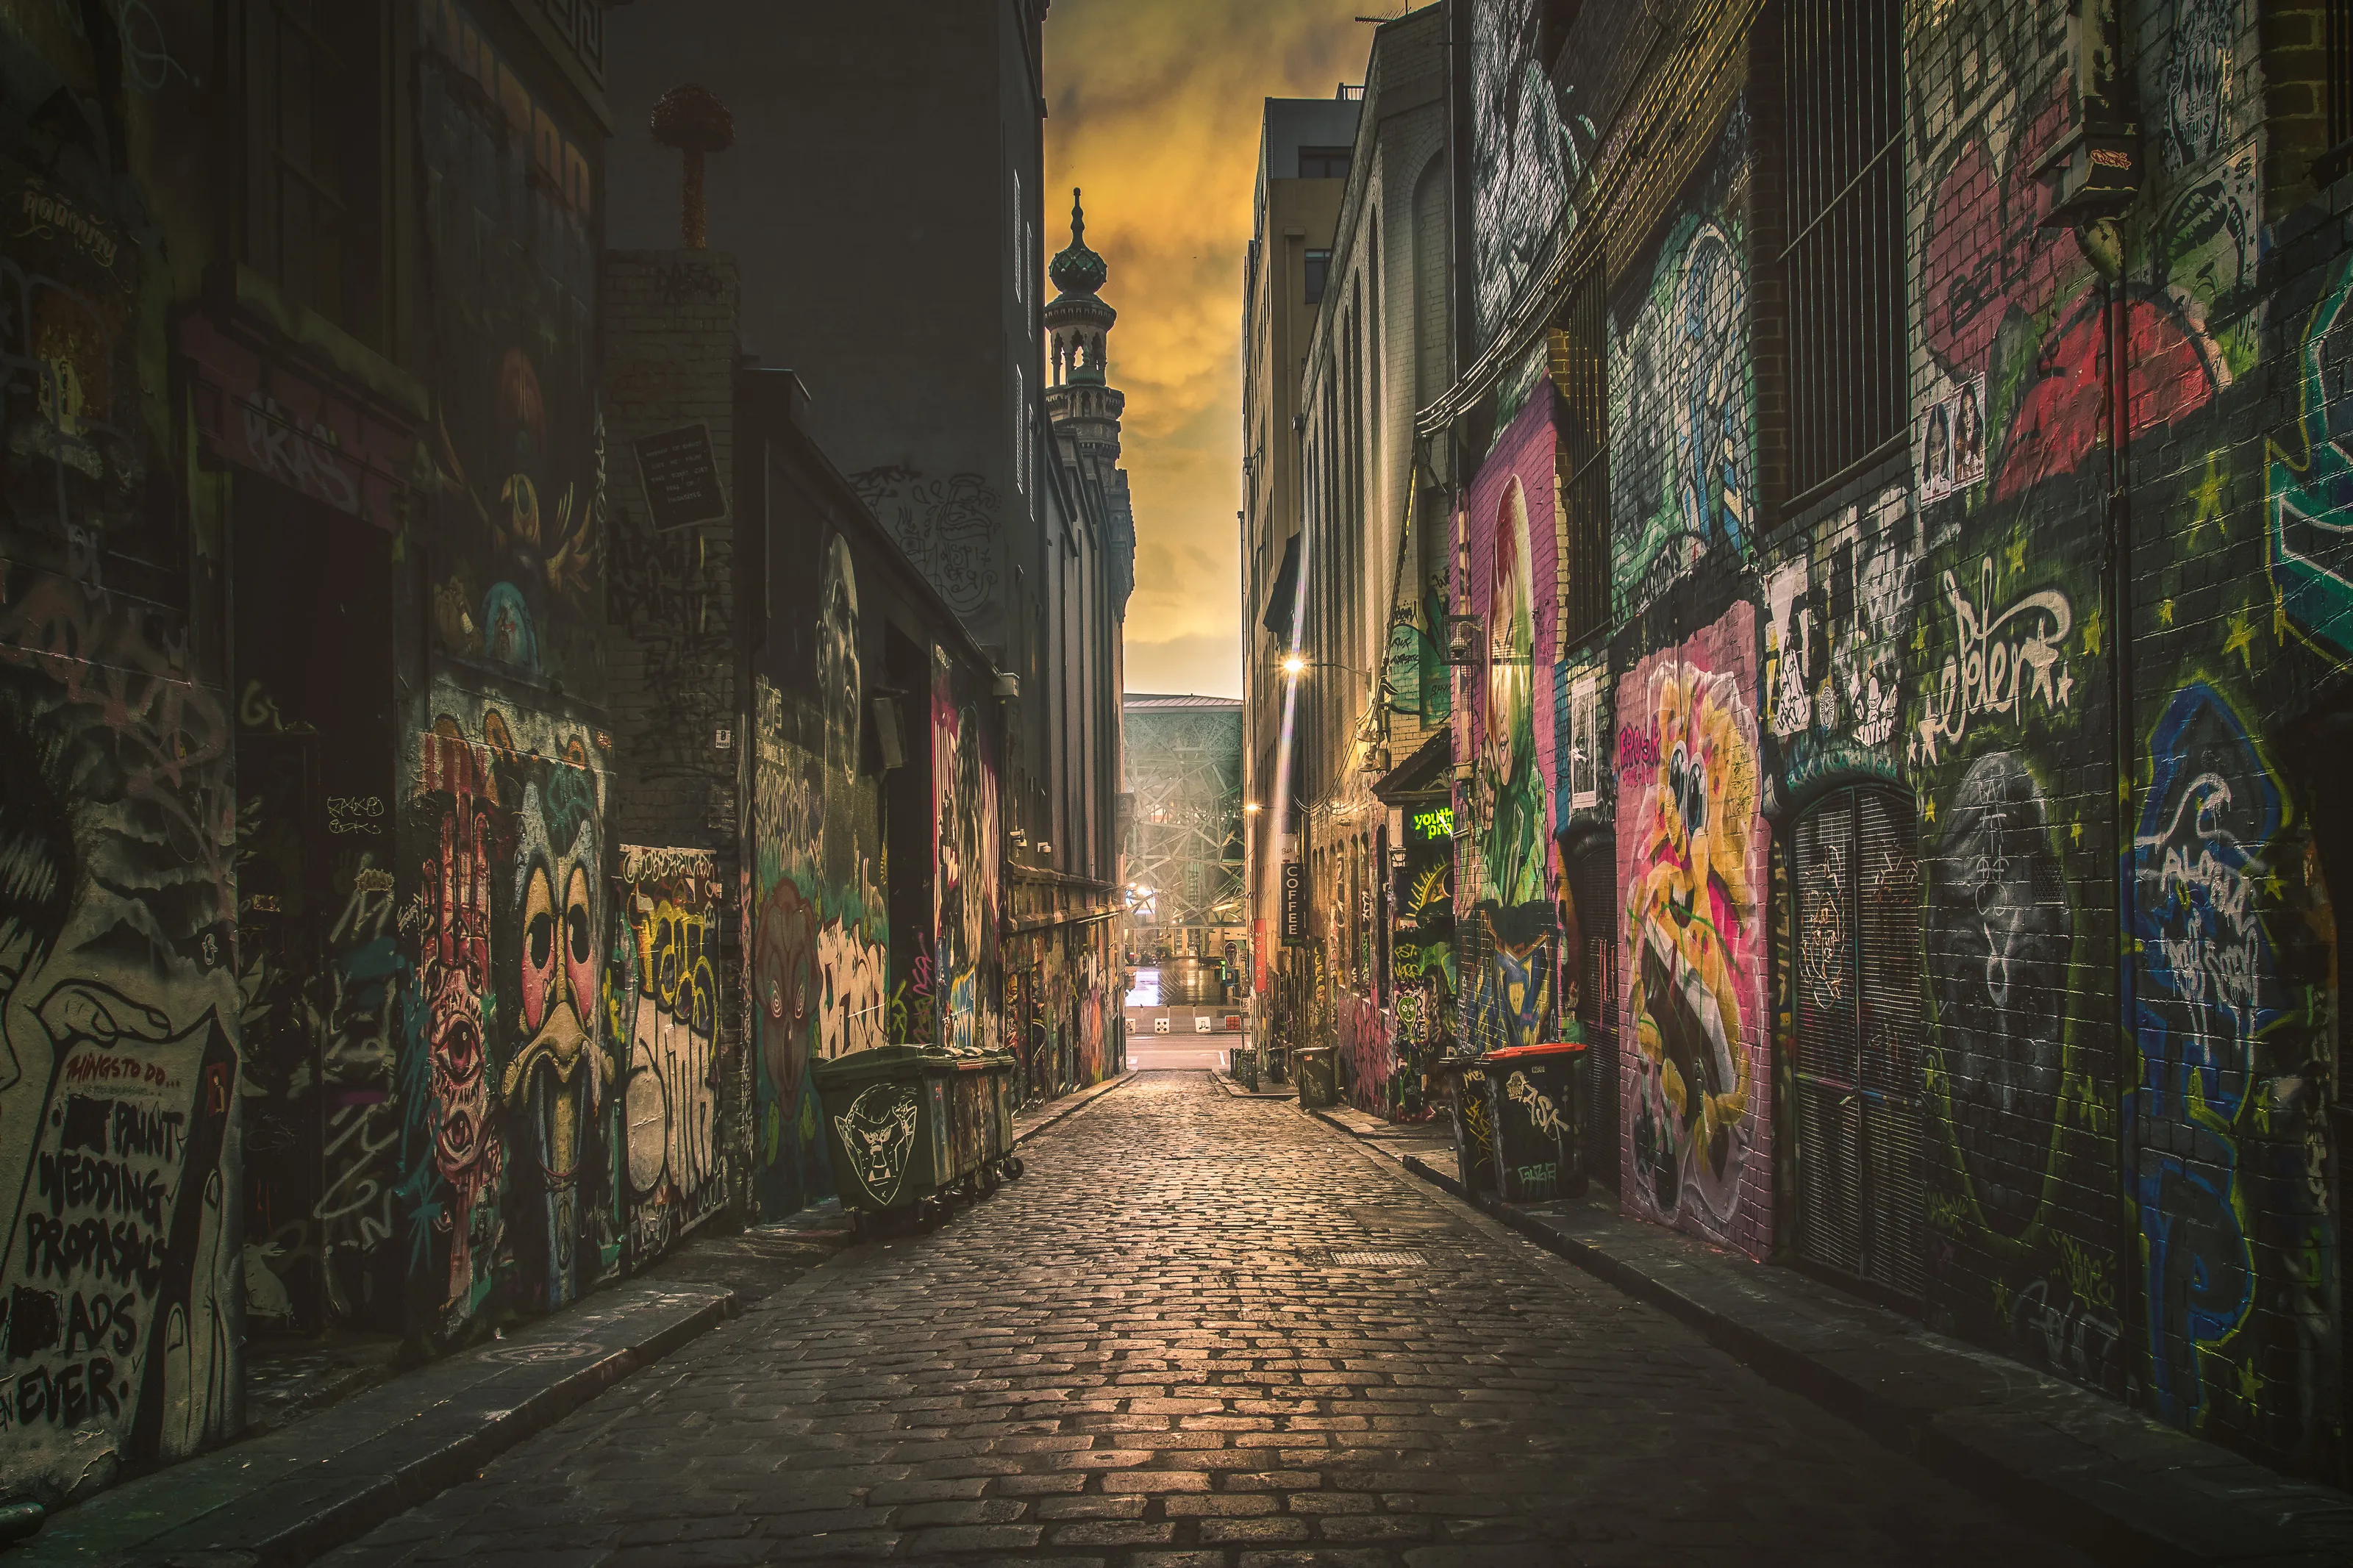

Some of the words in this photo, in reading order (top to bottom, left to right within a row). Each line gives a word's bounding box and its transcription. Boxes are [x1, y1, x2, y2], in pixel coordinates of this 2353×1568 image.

[2185, 91, 2211, 118] SELFIE
[2185, 114, 2211, 146] THIS
[1414, 808, 1453, 830] youth
[1287, 866, 1299, 935] COFFEE
[121, 1059, 141, 1079] TO
[113, 1100, 184, 1163] PAINT
[38, 1150, 167, 1233] WEDDING
[65, 1291, 138, 1359] ADS
